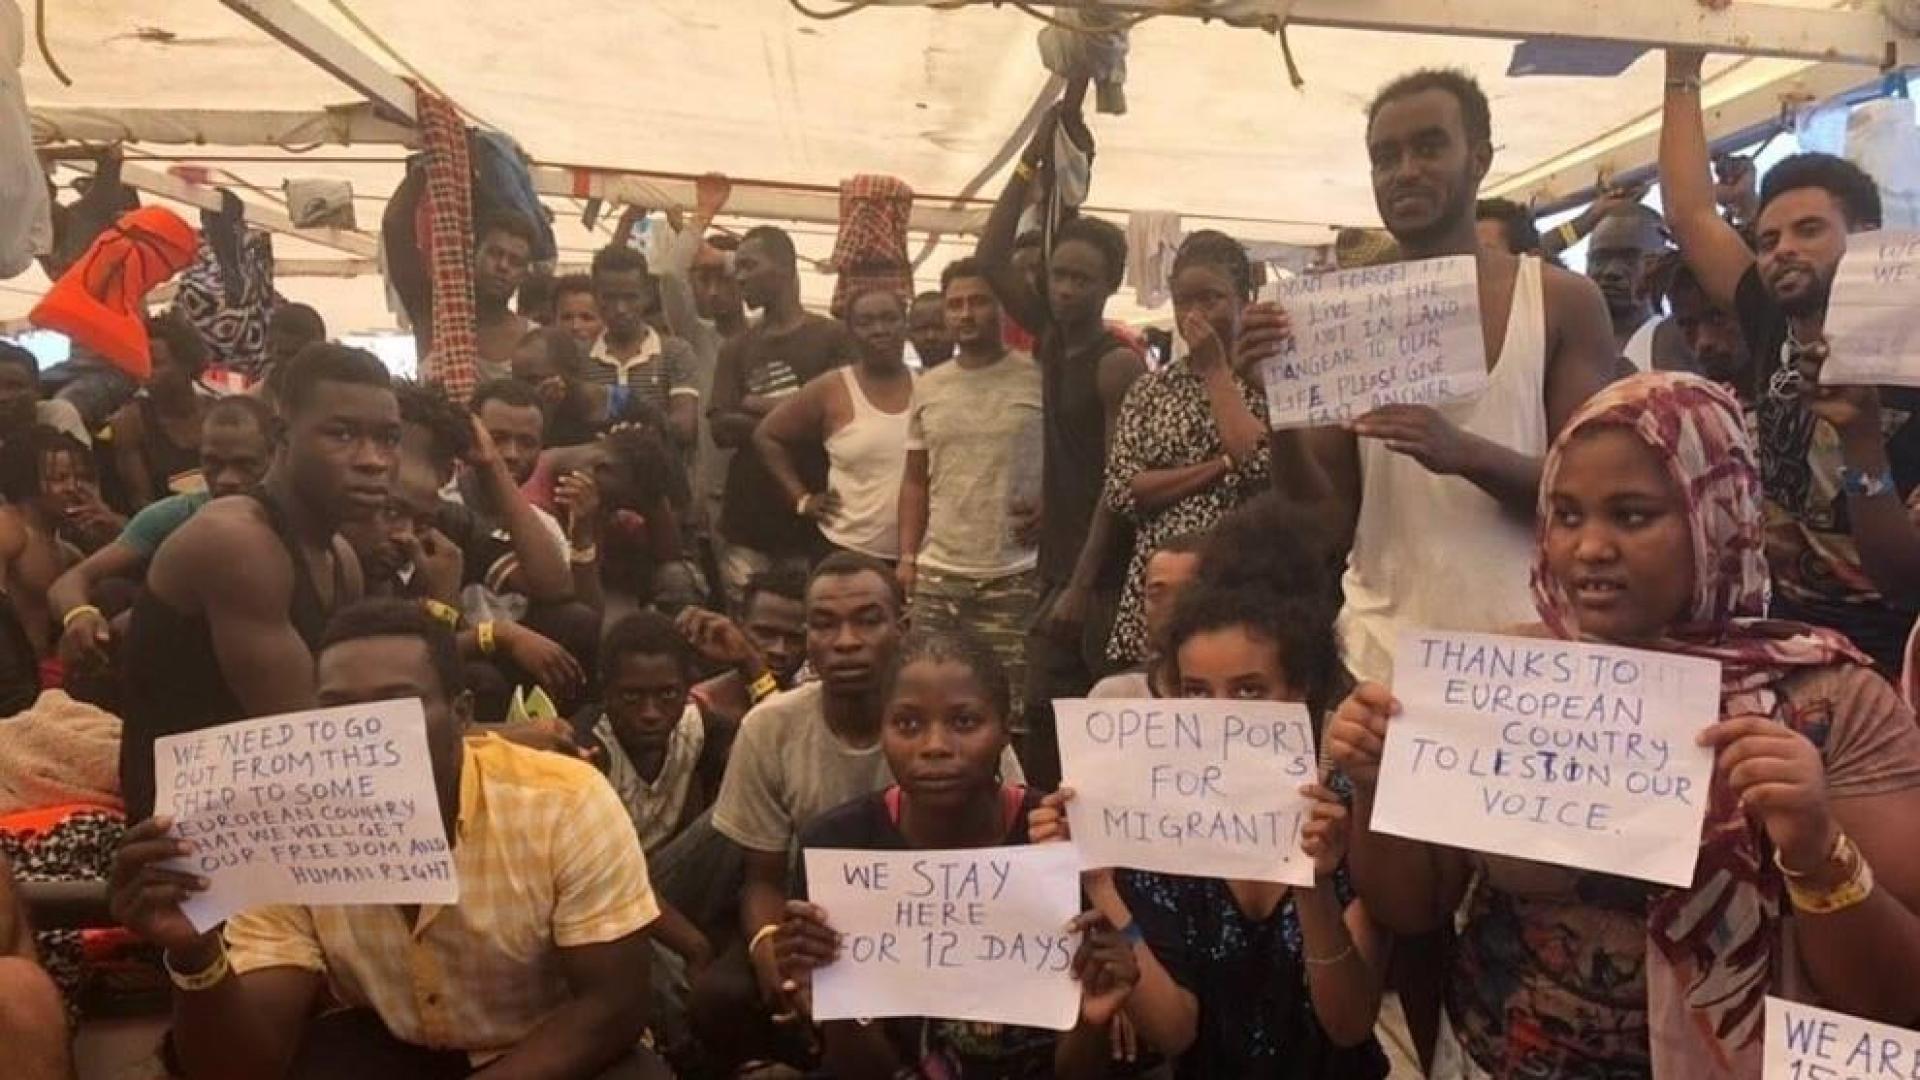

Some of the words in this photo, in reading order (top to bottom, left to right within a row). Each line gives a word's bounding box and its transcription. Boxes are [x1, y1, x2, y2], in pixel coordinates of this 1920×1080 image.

[1338, 265, 1406, 288] FORGET
[1368, 290, 1392, 312] IN
[1406, 280, 1443, 302] THE
[1314, 325, 1346, 344] NOT
[1363, 317, 1393, 338] IN
[1405, 300, 1459, 327] LAND
[1367, 341, 1385, 359] TO
[1398, 328, 1441, 356] OUR
[1273, 385, 1323, 412] LIFE
[1405, 355, 1444, 384] GIVE
[1421, 639, 1571, 683] THANKS
[1590, 655, 1639, 686] TO
[1444, 679, 1643, 726] EUROPEAN
[173, 738, 206, 766] WE
[218, 724, 294, 755] NEED
[305, 720, 337, 744] TO
[345, 717, 382, 740] GO
[1085, 709, 1202, 749] OPEN
[1503, 720, 1669, 771] COUNTRY
[174, 765, 217, 790] OUT
[232, 752, 314, 782] FROM
[319, 740, 401, 770] THIS
[1150, 765, 1228, 799] FOR
[1412, 738, 1458, 774] TO
[1626, 770, 1692, 805] OUR
[172, 786, 236, 817] SHIP
[249, 783, 286, 808] TO
[294, 775, 376, 805] SOME
[1483, 787, 1622, 835] VOICE.
[176, 806, 314, 838] EUROPEAN
[247, 826, 280, 844] WE
[291, 823, 355, 839] WILL
[358, 821, 405, 838] GET
[201, 847, 256, 873] OUR
[289, 865, 375, 885] HUMAN
[379, 861, 448, 882] RIGHT
[843, 862, 889, 890] WE
[904, 860, 1010, 901] STAY
[896, 901, 986, 928] HERE
[922, 931, 963, 969] 12
[976, 931, 1071, 972] DAYS
[1785, 1011, 1838, 1059] WE
